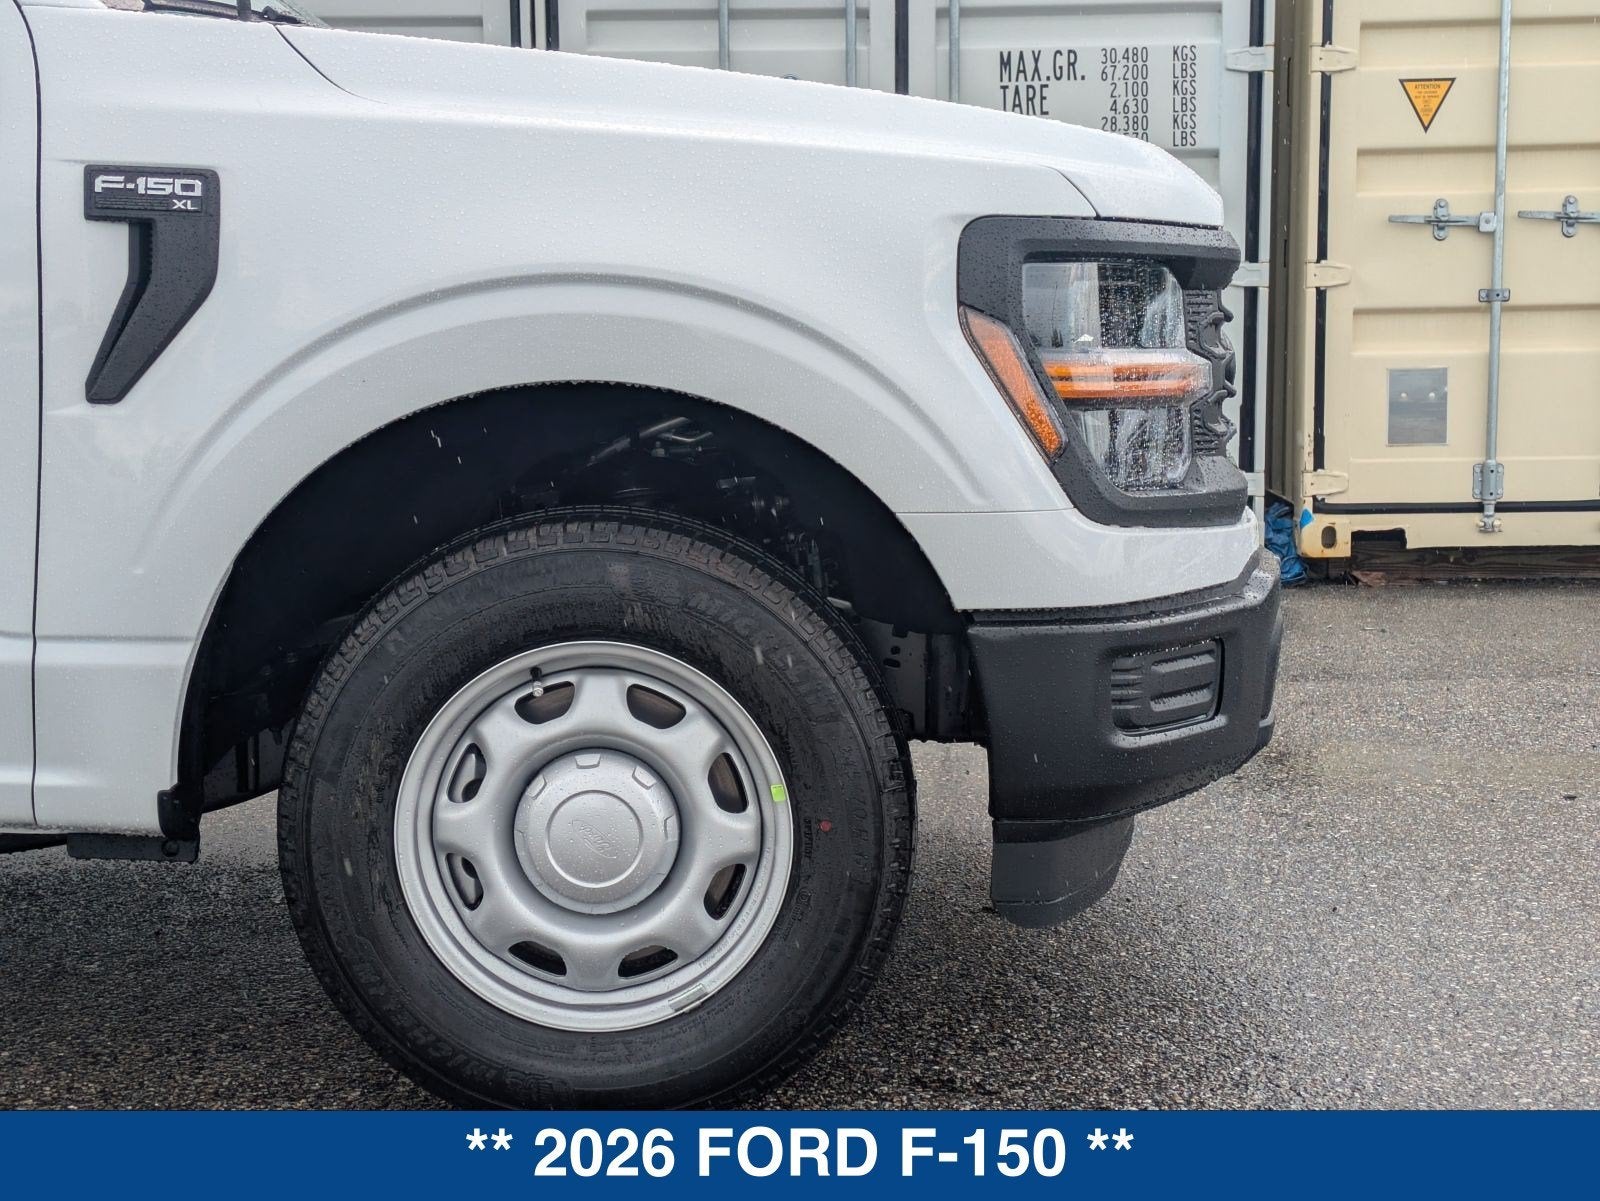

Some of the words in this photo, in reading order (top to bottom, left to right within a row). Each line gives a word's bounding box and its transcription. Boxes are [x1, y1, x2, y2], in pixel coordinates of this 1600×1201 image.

[1000, 49, 1086, 83] MAX.GR.
[1101, 46, 1149, 65] 30.480
[1173, 45, 1197, 62] KGS
[1101, 64, 1149, 82] 67.200
[1173, 62, 1197, 79] LBS
[1000, 83, 1050, 116] TARE
[1110, 81, 1149, 99] 2.100
[1173, 79, 1197, 96] KGS
[1109, 98, 1149, 115] 4.630
[1173, 96, 1197, 113] LBS
[1101, 115, 1149, 132] 28.380
[1173, 113, 1197, 130] KGS
[1173, 130, 1197, 147] LBS
[94, 174, 203, 197] F-150
[172, 199, 199, 210] XL
